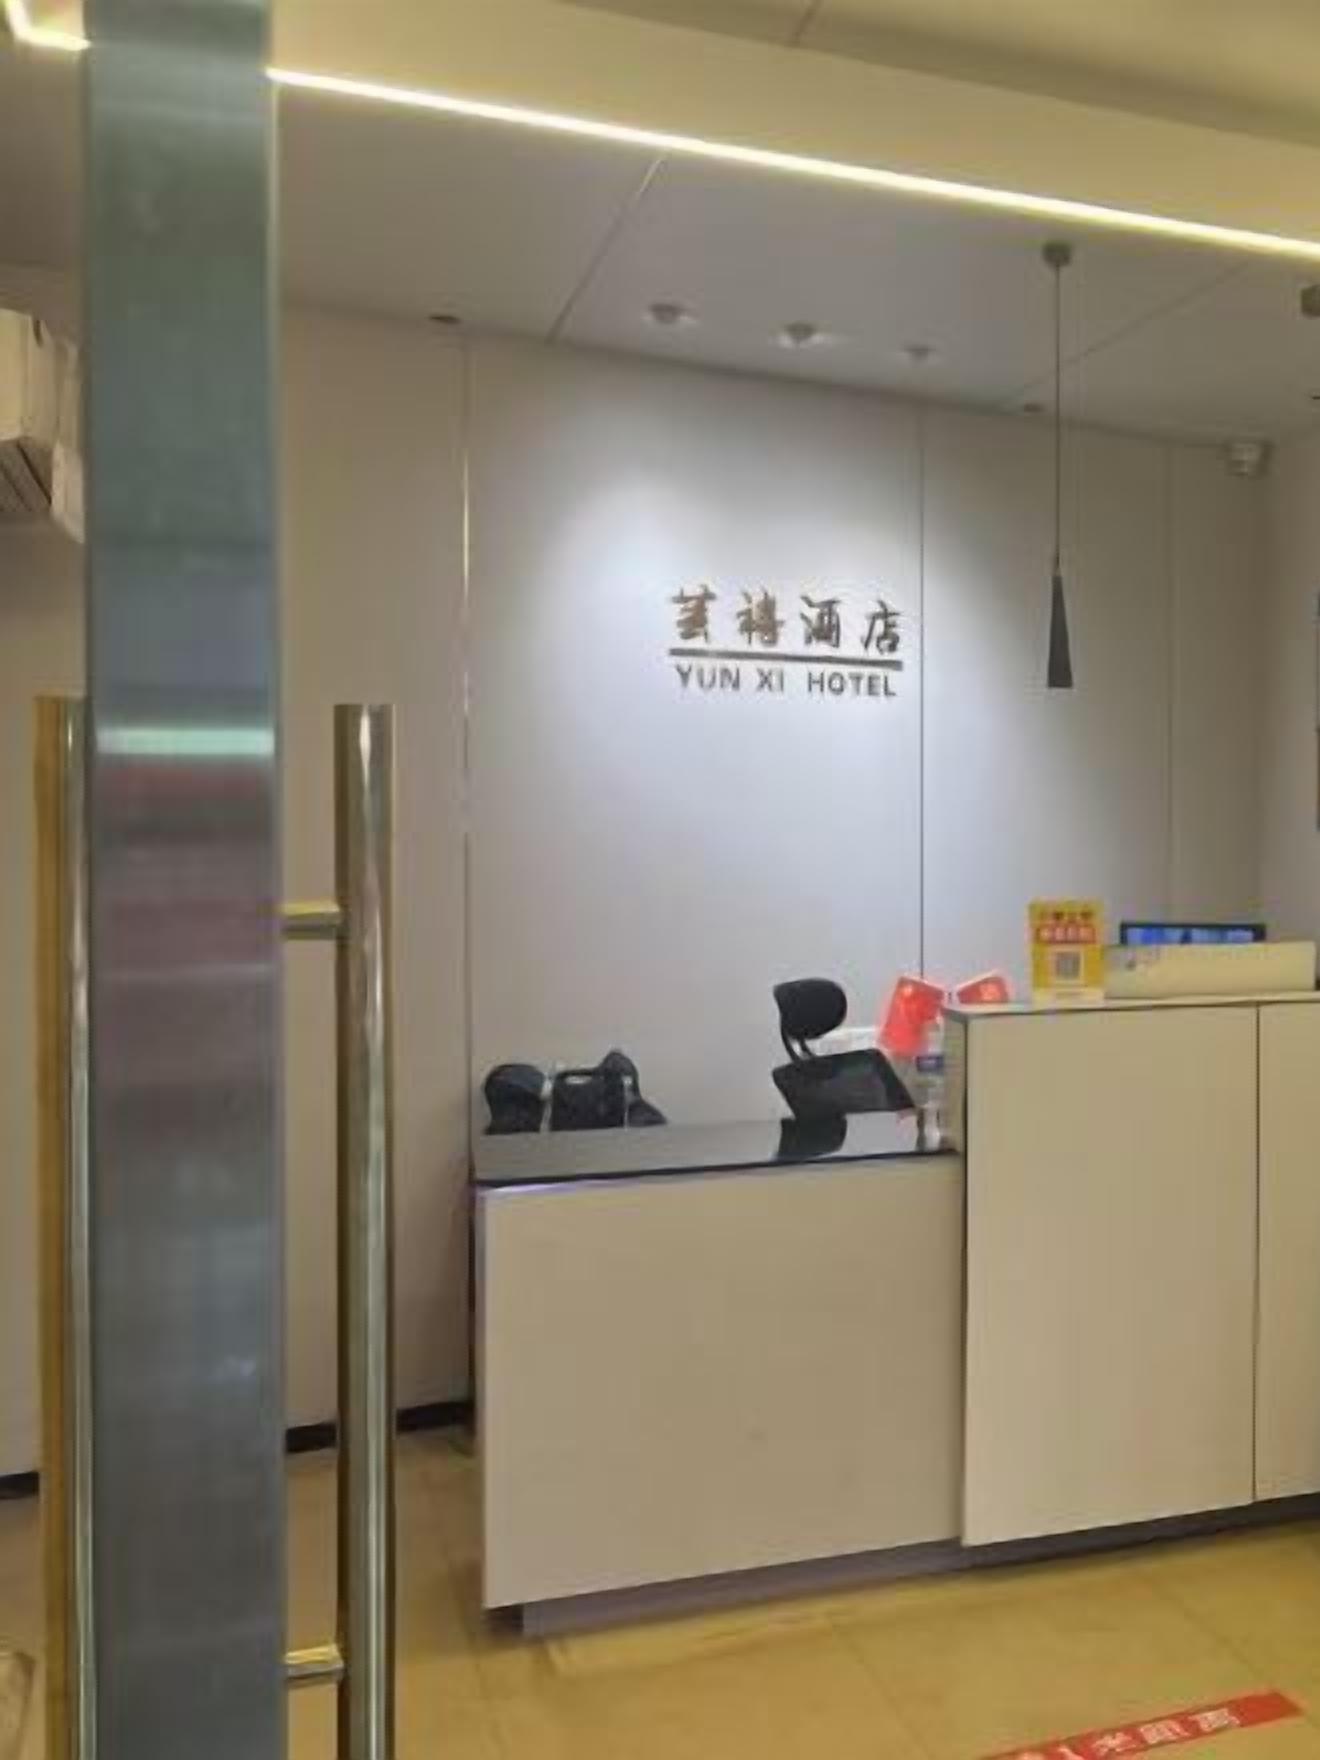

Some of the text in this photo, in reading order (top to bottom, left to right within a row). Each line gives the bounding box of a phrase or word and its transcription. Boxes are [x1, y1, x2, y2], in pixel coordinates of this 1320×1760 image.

[676, 665, 897, 697] YUN XI HOTEL
